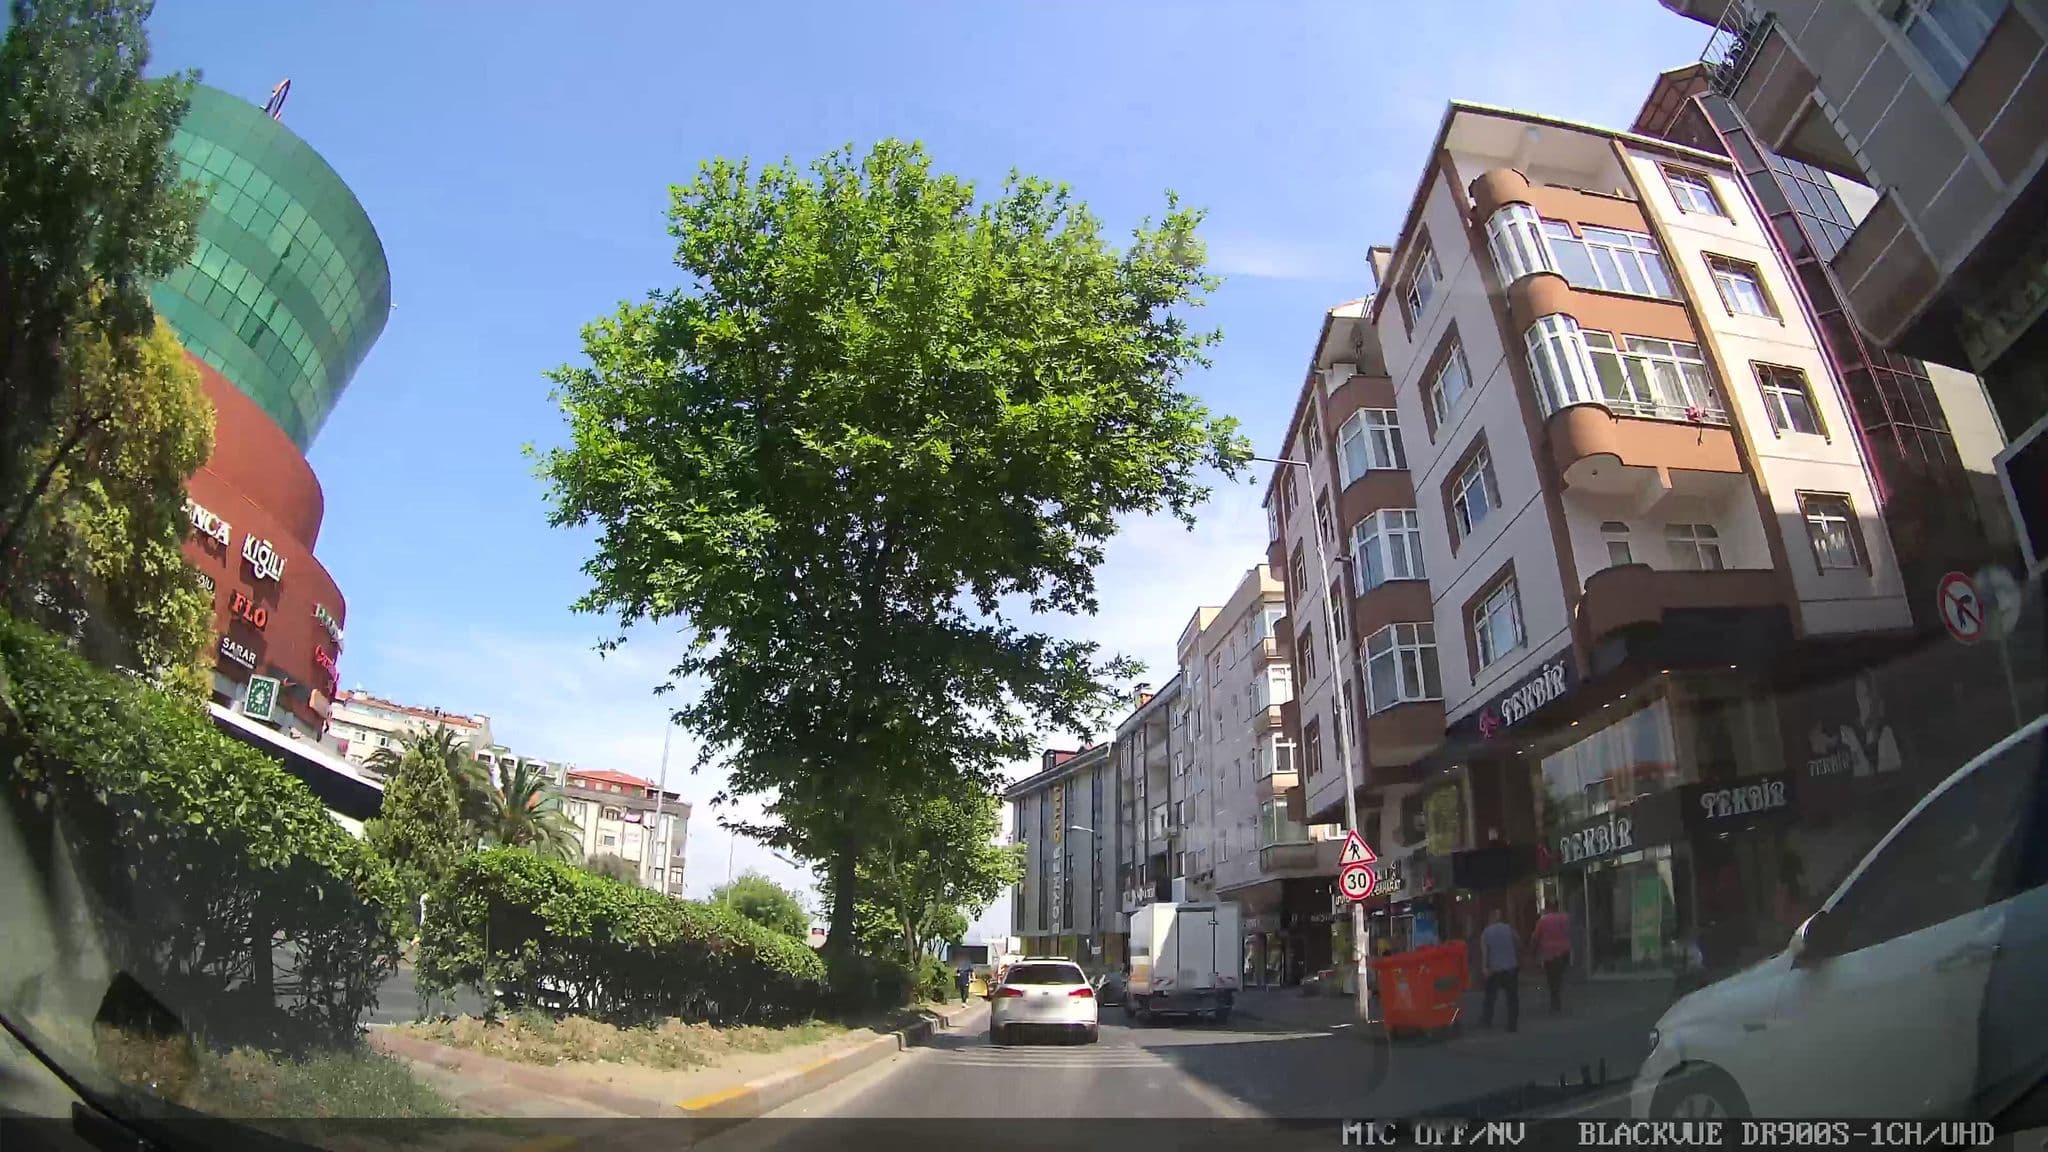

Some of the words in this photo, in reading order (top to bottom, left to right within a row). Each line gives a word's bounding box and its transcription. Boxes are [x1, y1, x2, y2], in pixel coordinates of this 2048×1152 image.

[231, 592, 267, 628] FLO
[222, 637, 257, 664] SARAR
[1347, 873, 1367, 890] 30
